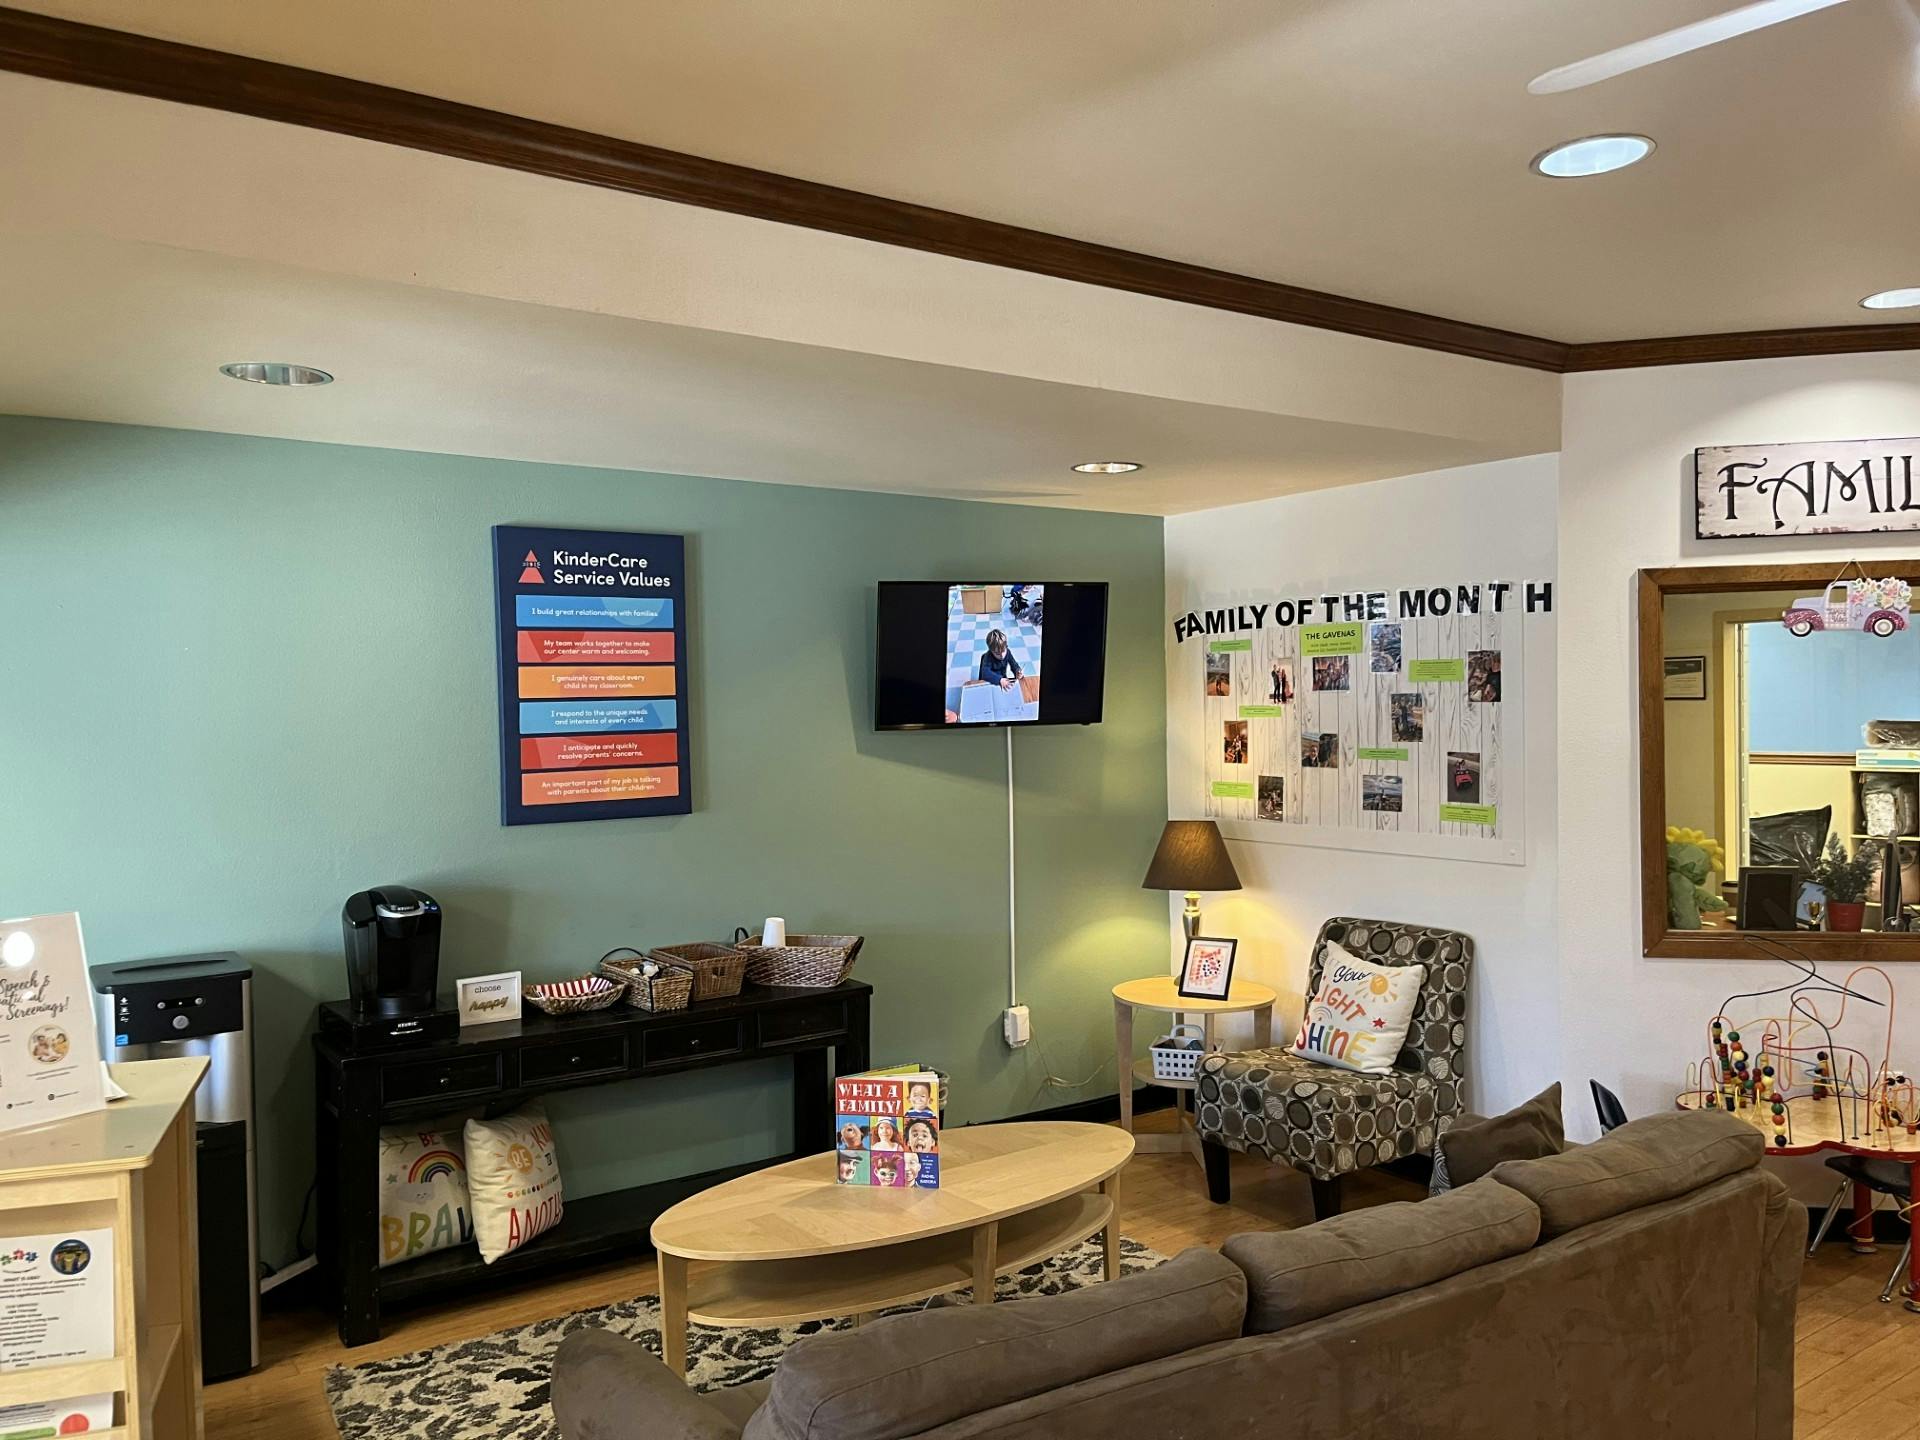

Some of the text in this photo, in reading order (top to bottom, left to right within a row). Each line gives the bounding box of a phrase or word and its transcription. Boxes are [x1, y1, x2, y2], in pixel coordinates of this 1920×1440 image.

[1717, 455, 1920, 529] FAMIL
[553, 551, 648, 568] KinderCare
[553, 570, 671, 587] Service Values
[531, 607, 536, 615] I
[537, 607, 554, 615] build
[555, 609, 574, 617] great
[575, 609, 618, 618] relationships
[619, 609, 633, 617] with
[1174, 604, 1269, 643] FAMILY
[1275, 599, 1313, 626] OF
[1321, 592, 1387, 622] THE
[1305, 629, 1356, 640] THE GAVENAS
[543, 639, 555, 648] My
[595, 640, 625, 648] together
[601, 647, 614, 655] and
[556, 674, 588, 683] genuinely
[555, 710, 584, 718] respond
[593, 709, 604, 717] the
[605, 709, 627, 717] unique
[567, 744, 601, 752] anticipate
[615, 742, 638, 751] quickly
[552, 780, 585, 789] important
[587, 779, 602, 787] part
[610, 778, 621, 786] my
[621, 777, 632, 786] job
[639, 776, 661, 784] talking
[562, 788, 590, 796] parents
[474, 984, 502, 994] choose
[468, 996, 509, 1012] happy
[838, 1083, 898, 1097] WHAT A
[839, 1098, 902, 1114] FAMILY!
[418, 1131, 440, 1147] BE
